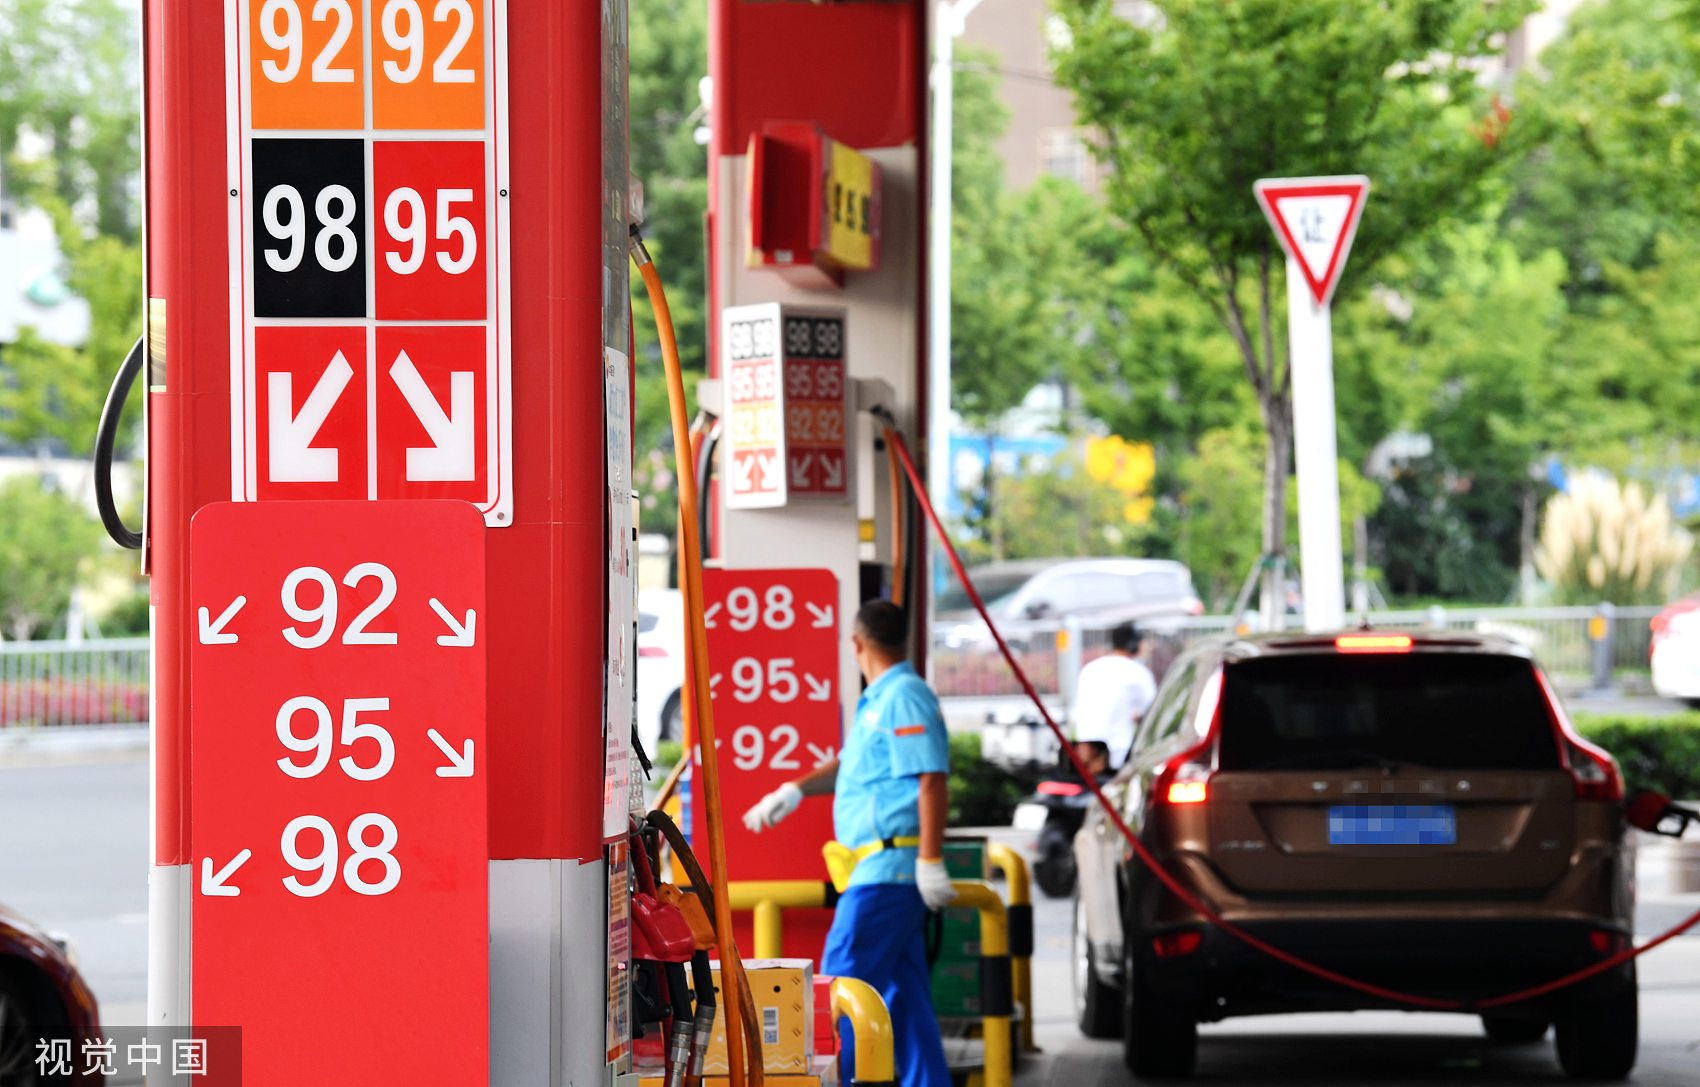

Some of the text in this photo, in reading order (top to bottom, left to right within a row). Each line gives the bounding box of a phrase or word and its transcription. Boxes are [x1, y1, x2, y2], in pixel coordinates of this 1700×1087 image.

[260, 0, 475, 83] 92 92
[262, 184, 477, 275] 98 95
[787, 319, 840, 355] 98 98
[787, 364, 841, 397] 95 95
[789, 408, 841, 440] 92 92
[281, 562, 398, 649] 92
[726, 585, 795, 632] 98
[731, 657, 799, 703] 95
[275, 696, 395, 781] 95
[732, 724, 800, 770] 92
[280, 812, 402, 897] 98
